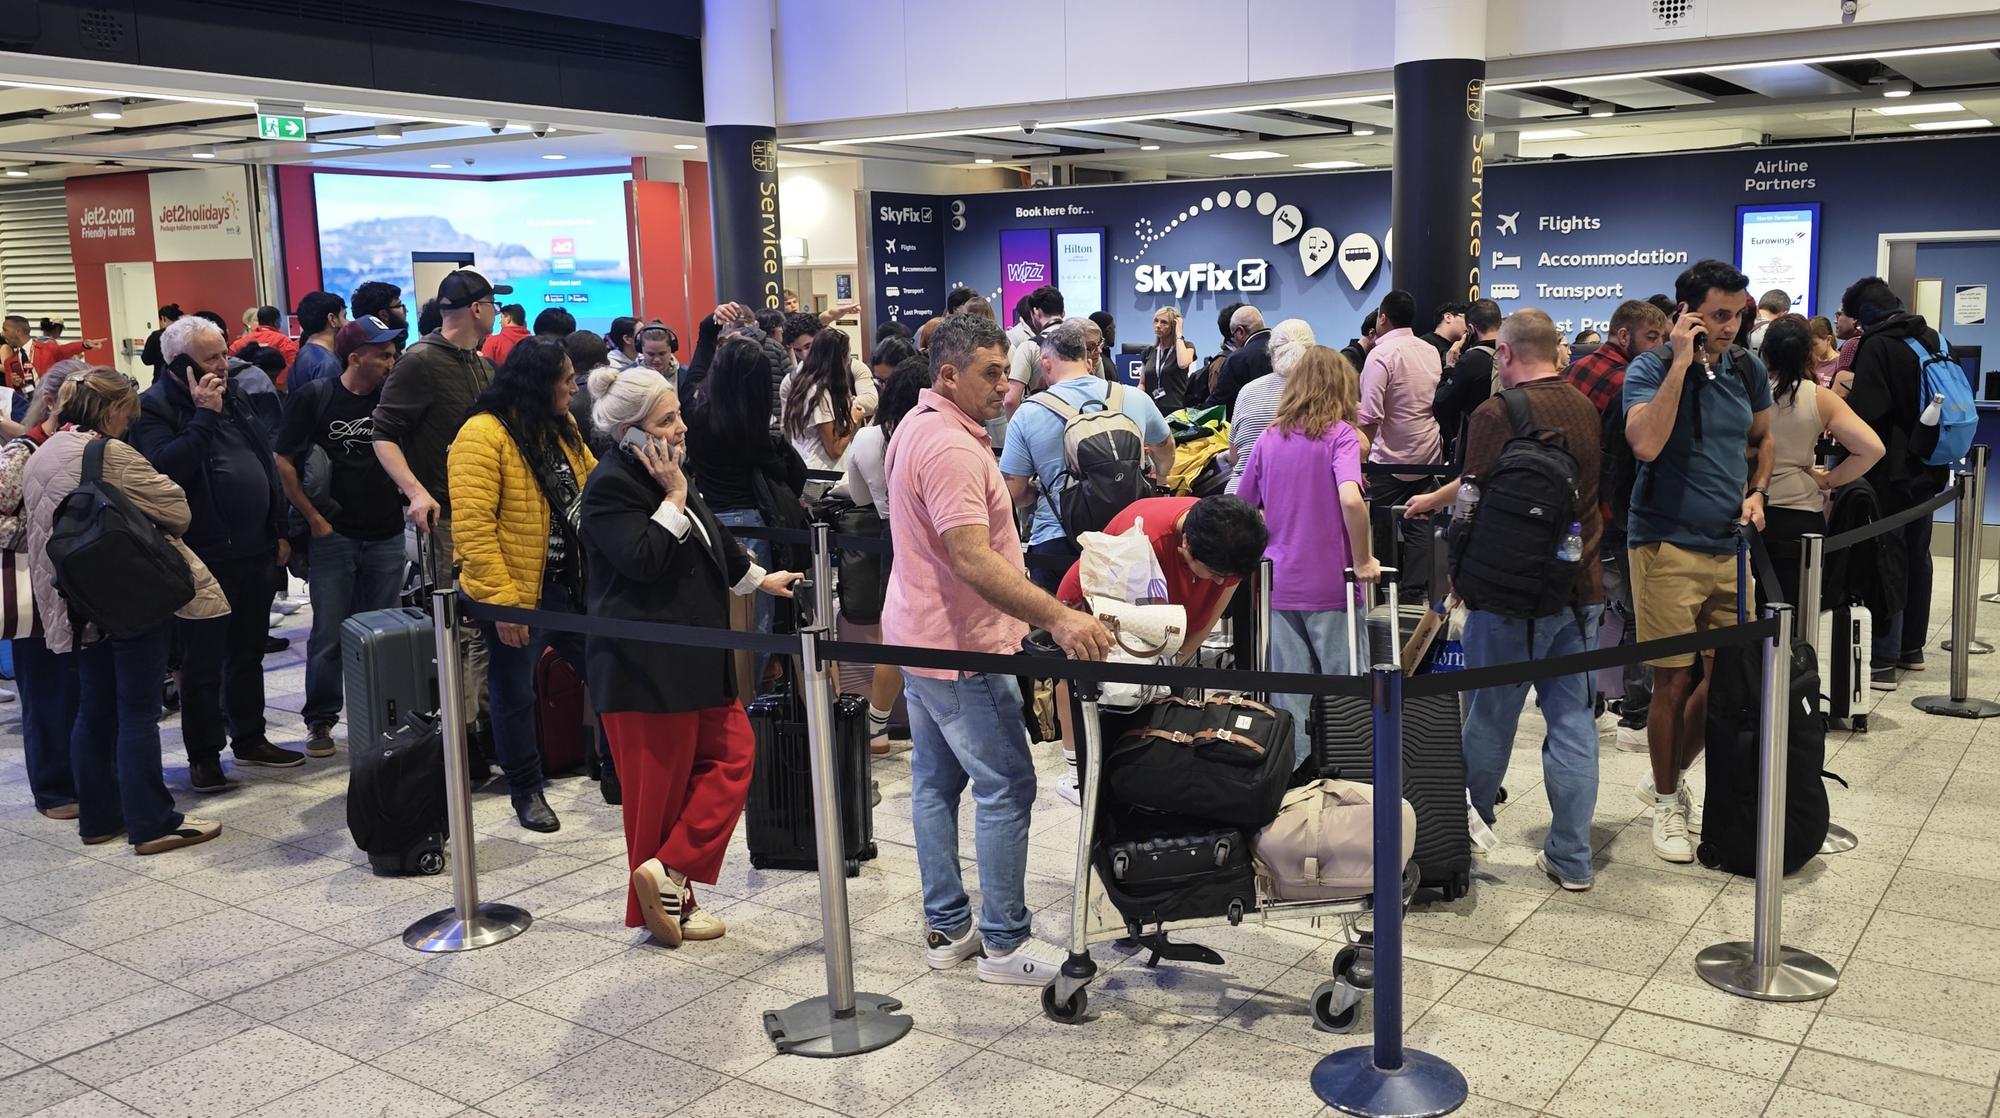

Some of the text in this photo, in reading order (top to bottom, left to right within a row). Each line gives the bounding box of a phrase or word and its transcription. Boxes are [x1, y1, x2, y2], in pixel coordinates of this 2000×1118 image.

[1754, 160, 1808, 174] Airline
[1744, 178, 1816, 192] Partners
[80, 206, 135, 226] Jet2.com
[159, 203, 230, 224] Jet2holidays
[880, 206, 920, 225] SkyFix
[1016, 204, 1094, 218] Book here for...
[1469, 135, 1484, 302] Service ce
[1539, 215, 1601, 234] Flights
[81, 225, 136, 240] Friendly low fares
[760, 182, 780, 310] Service ce
[900, 244, 917, 252] Flights
[1751, 236, 1795, 246] Eurowings
[1064, 244, 1092, 254] Hilton
[1537, 249, 1688, 267] Accommodation
[1135, 262, 1234, 299] SkyFix
[903, 287, 924, 295] Transport
[1536, 283, 1623, 300] Transport
[914, 308, 933, 316] Property
[1555, 318, 1610, 333] st Pro
